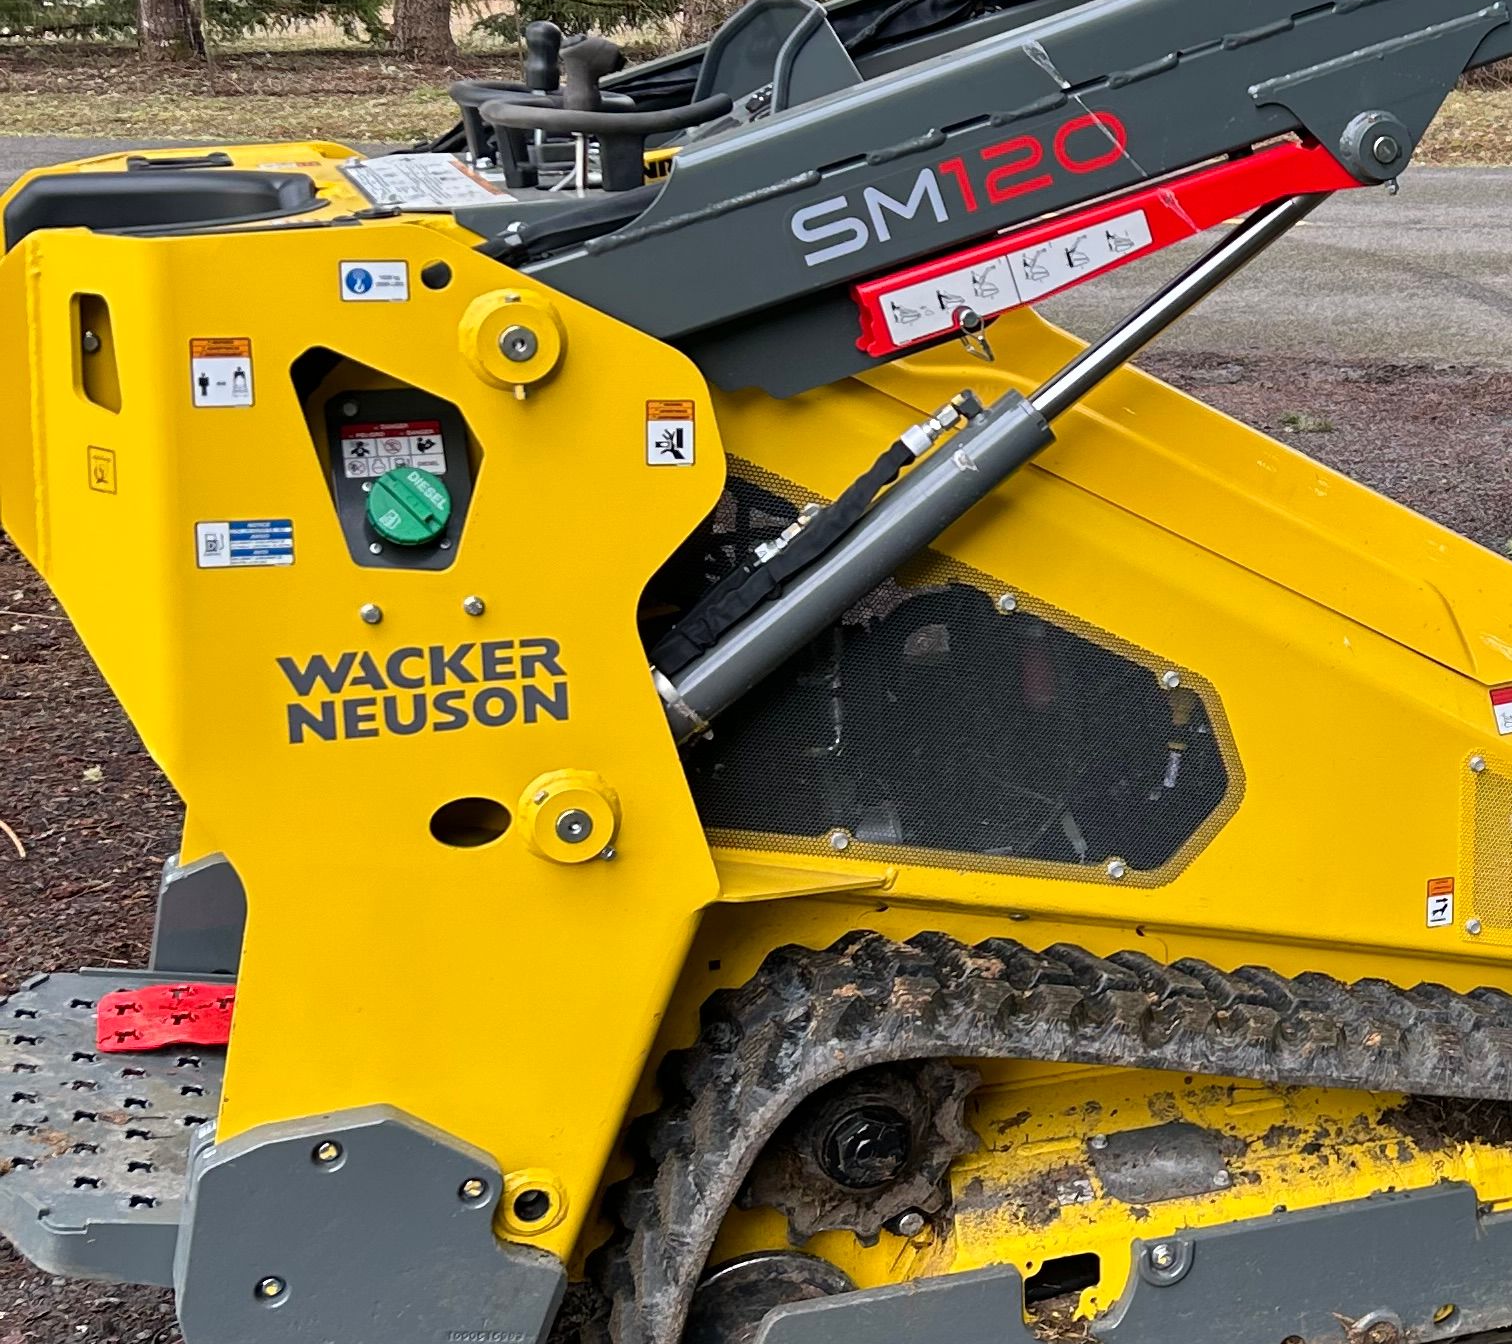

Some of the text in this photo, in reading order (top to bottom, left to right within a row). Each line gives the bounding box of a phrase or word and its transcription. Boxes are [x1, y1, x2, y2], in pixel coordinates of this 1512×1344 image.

[791, 111, 1128, 267] SM120
[407, 471, 446, 511] DIESEL
[275, 637, 568, 697] WACKER
[286, 681, 570, 744] NEUSON
